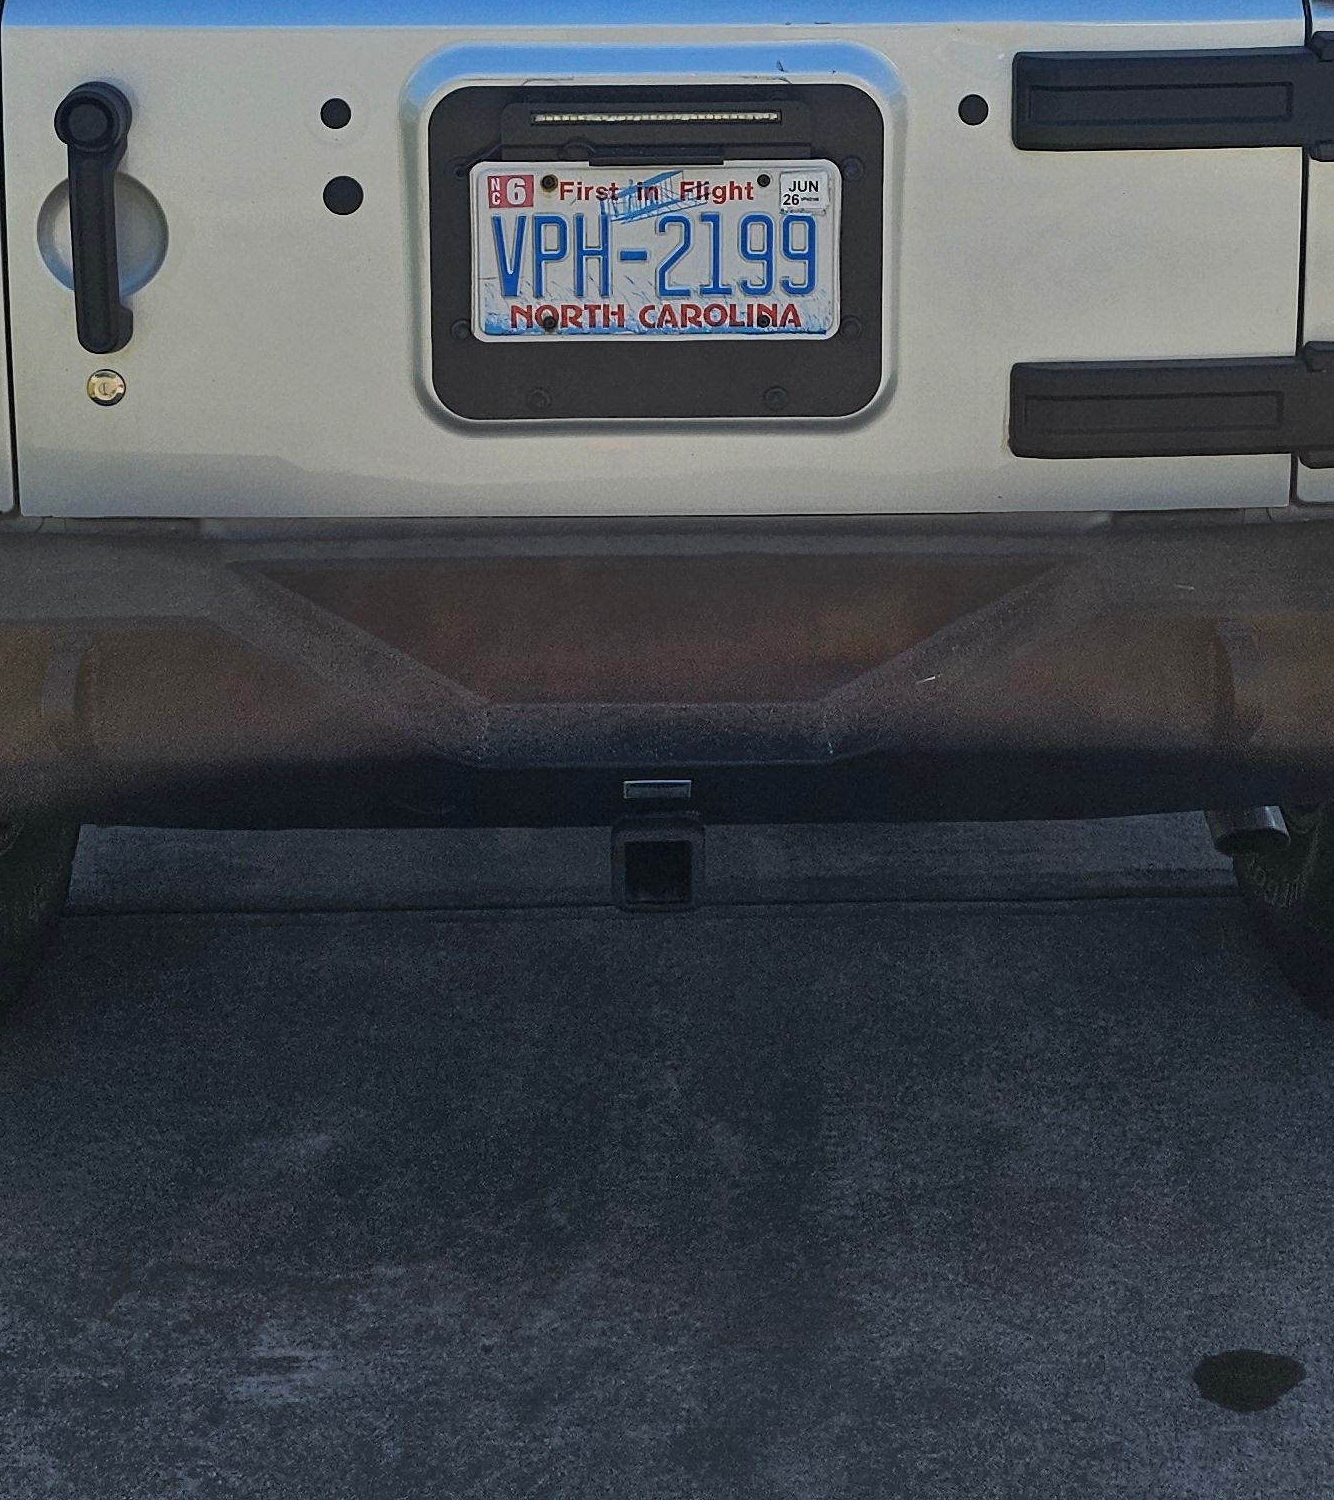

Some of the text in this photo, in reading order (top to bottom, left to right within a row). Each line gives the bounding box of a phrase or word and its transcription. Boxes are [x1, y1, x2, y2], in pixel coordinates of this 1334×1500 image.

[507, 177, 526, 205] 6
[559, 180, 754, 205] First in Flight
[788, 180, 819, 192] JUN
[491, 213, 818, 298] VPH-2199
[510, 303, 802, 329] NORTH CAROLINA
